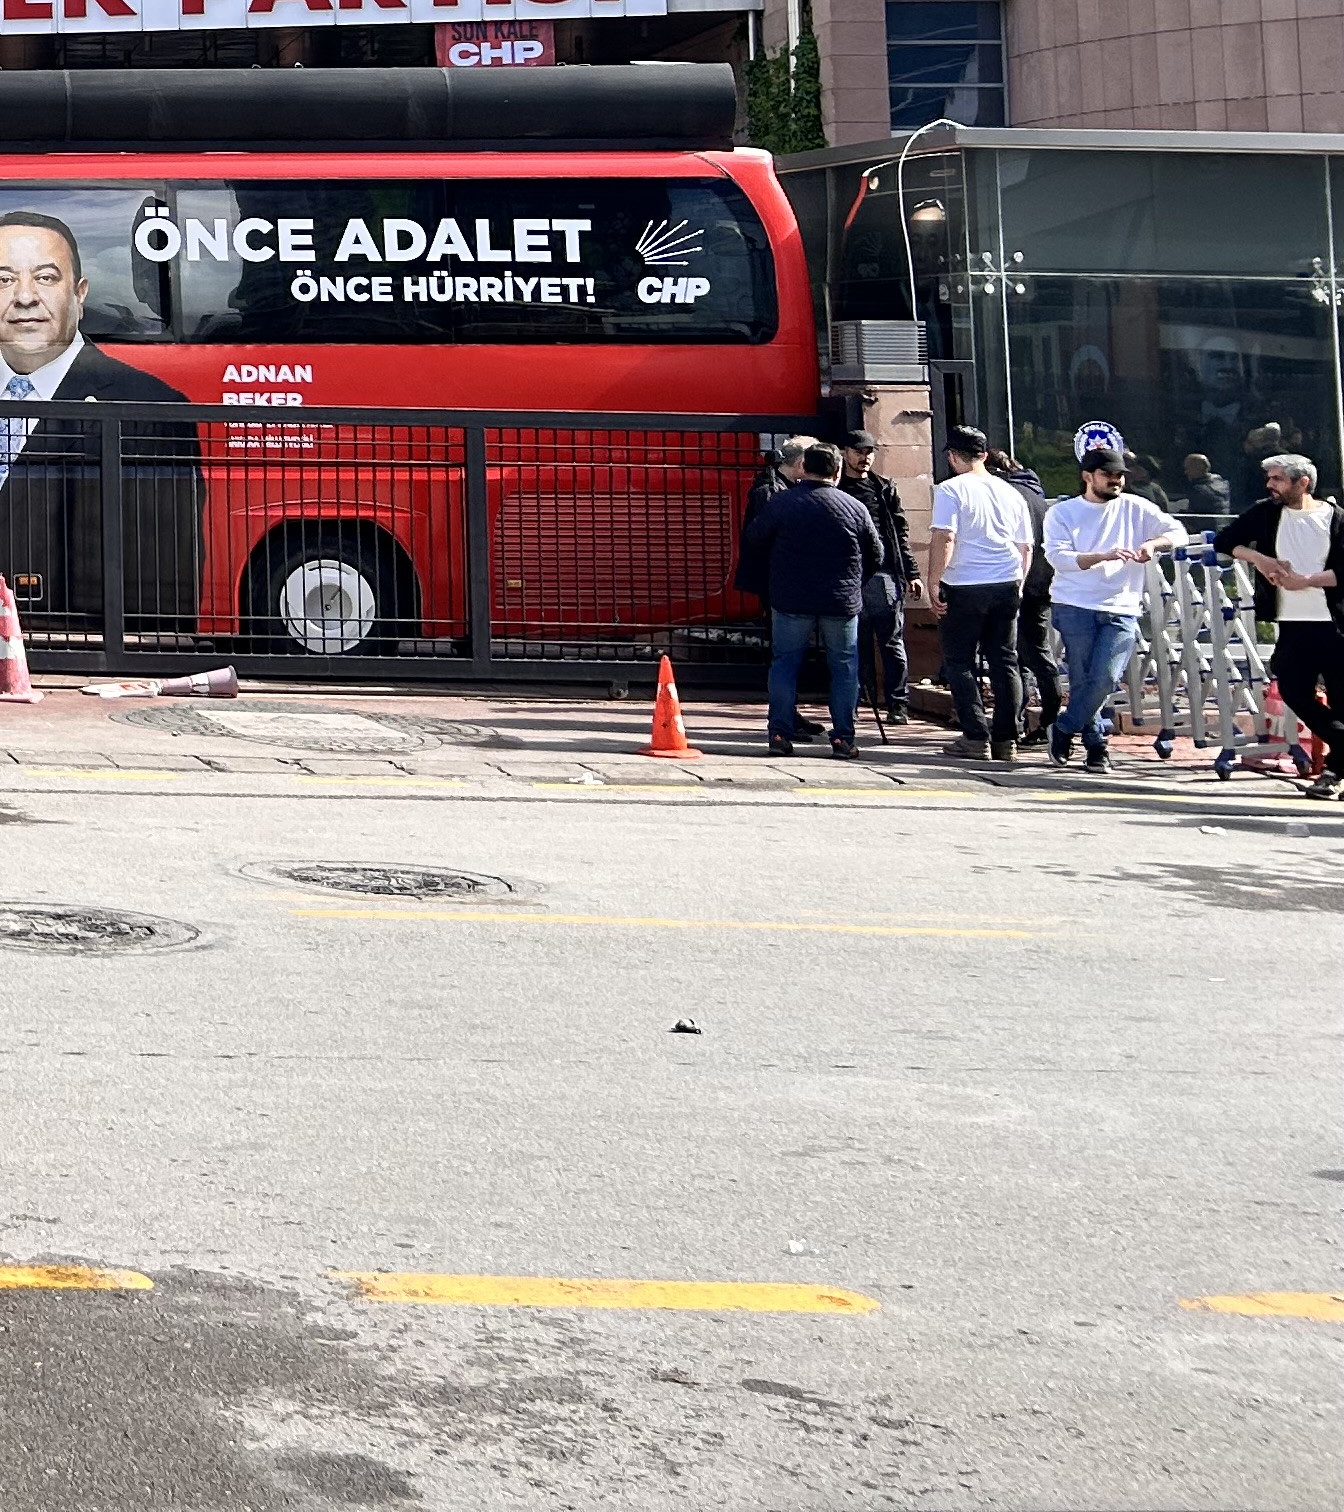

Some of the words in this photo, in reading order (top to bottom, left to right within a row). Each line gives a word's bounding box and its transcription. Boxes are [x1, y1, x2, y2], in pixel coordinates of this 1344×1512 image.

[495, 20, 539, 40] KALE
[449, 40, 544, 66] CHP
[134, 206, 315, 263] ÖNCE
[334, 218, 592, 263] ADALET
[290, 269, 394, 303] ÖNCE
[403, 269, 596, 304] HÜRRİYET!
[636, 276, 712, 304] CHP
[222, 364, 313, 383] ADNAN
[222, 392, 303, 407] BEKER
